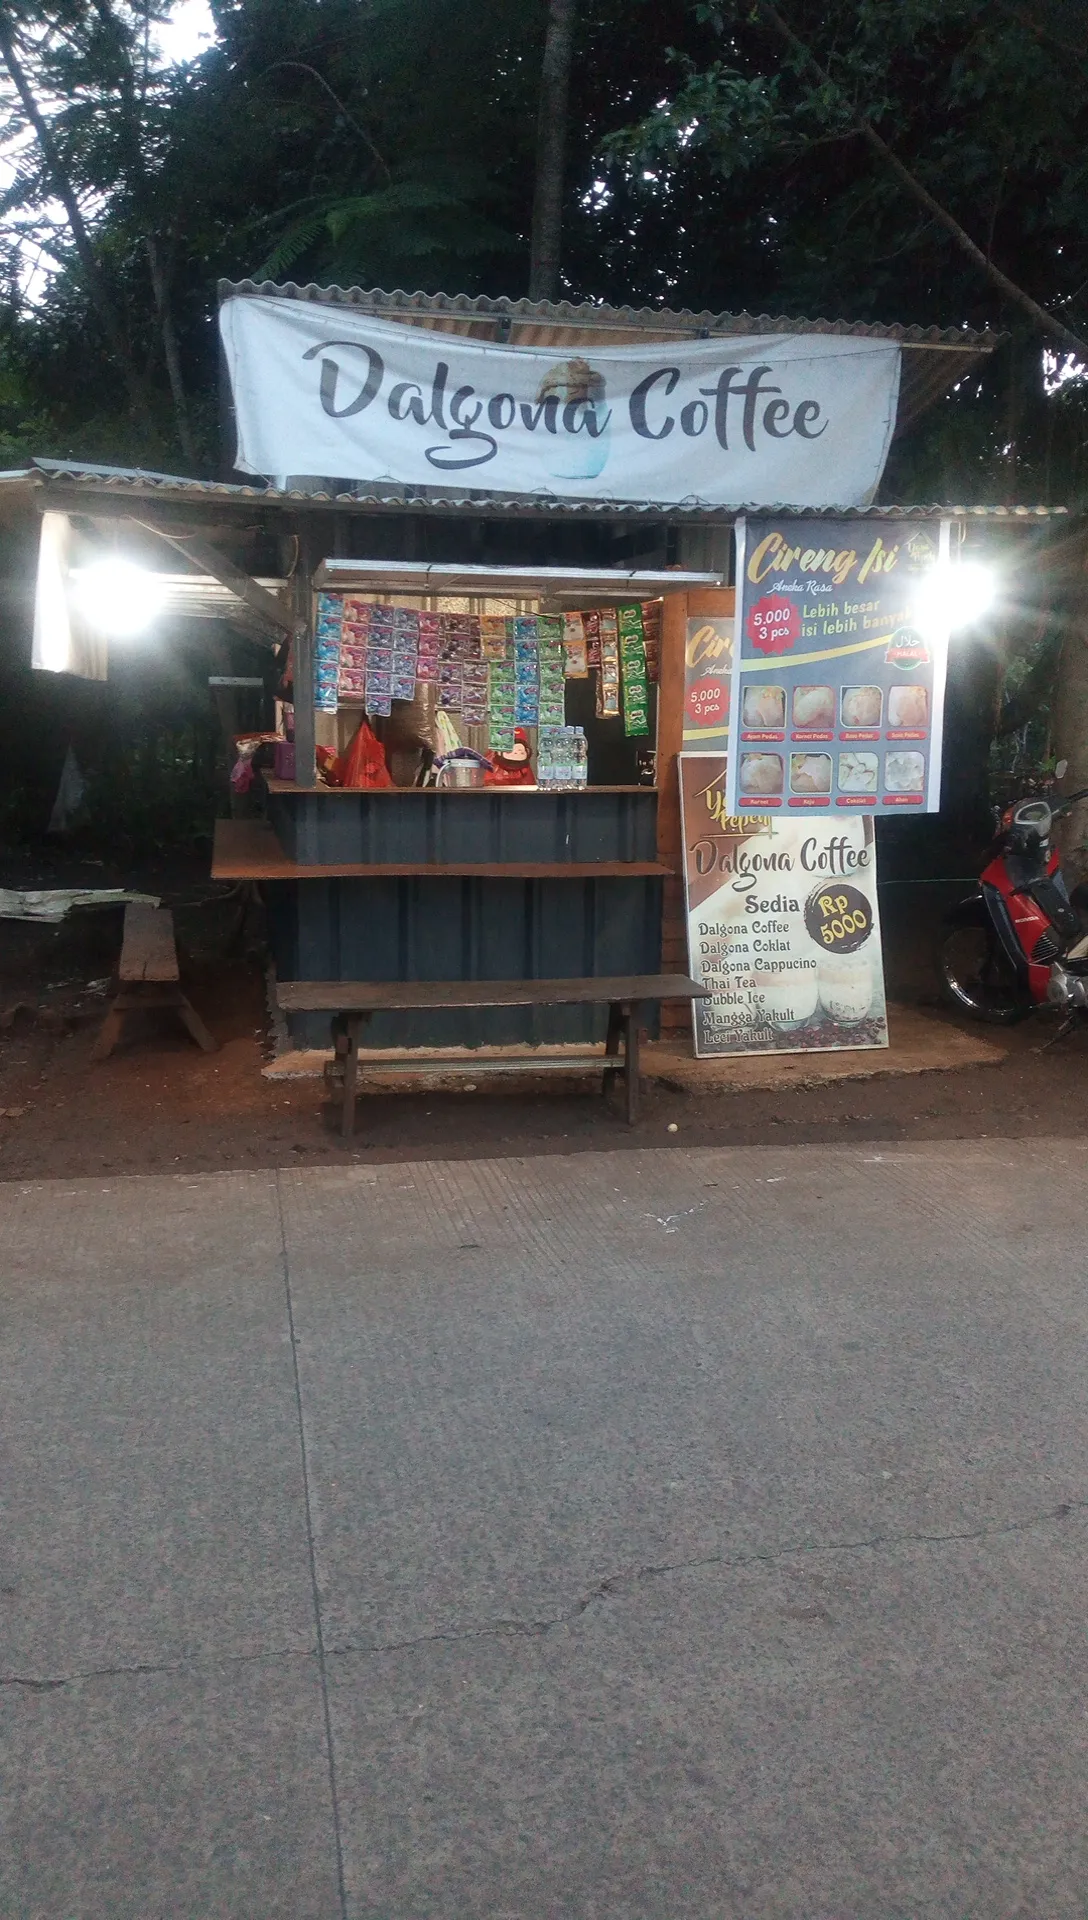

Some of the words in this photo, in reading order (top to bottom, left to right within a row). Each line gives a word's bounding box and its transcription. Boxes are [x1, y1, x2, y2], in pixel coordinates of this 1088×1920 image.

[302, 340, 614, 470] Dalgona
[628, 365, 830, 452] Coffee
[747, 532, 859, 584] Cireng
[857, 537, 902, 584] Isi
[766, 579, 804, 594] Aneka
[805, 579, 833, 595] Rasa
[753, 608, 791, 627] 5.000
[802, 602, 839, 619] Lebih
[844, 599, 881, 616] besar
[758, 627, 769, 641] 3
[770, 627, 790, 642] pcs
[800, 623, 818, 637] isi
[822, 618, 857, 636] lebih
[895, 634, 921, 648] حلال
[690, 688, 721, 703] 5.000
[694, 703, 702, 714] 3
[703, 702, 720, 715] pcs
[690, 840, 796, 892] Dalgona
[800, 836, 871, 874] Coffee
[745, 894, 800, 914] Sedia
[818, 894, 848, 918] Rp
[698, 921, 748, 937] Dalgona
[751, 919, 790, 933] Coffee
[820, 910, 867, 944] 5000
[699, 941, 749, 956] Dalgona
[753, 939, 791, 952] Coklat
[701, 959, 750, 975] Dalgona
[754, 957, 817, 973] Cappucino
[702, 977, 730, 989] Thai
[734, 976, 757, 988] Tea
[748, 991, 766, 1004] Ice
[703, 1010, 752, 1028] Mangga
[756, 1008, 795, 1022] Yakult
[704, 1029, 730, 1044] Leci
[734, 1027, 774, 1043] Yakult
